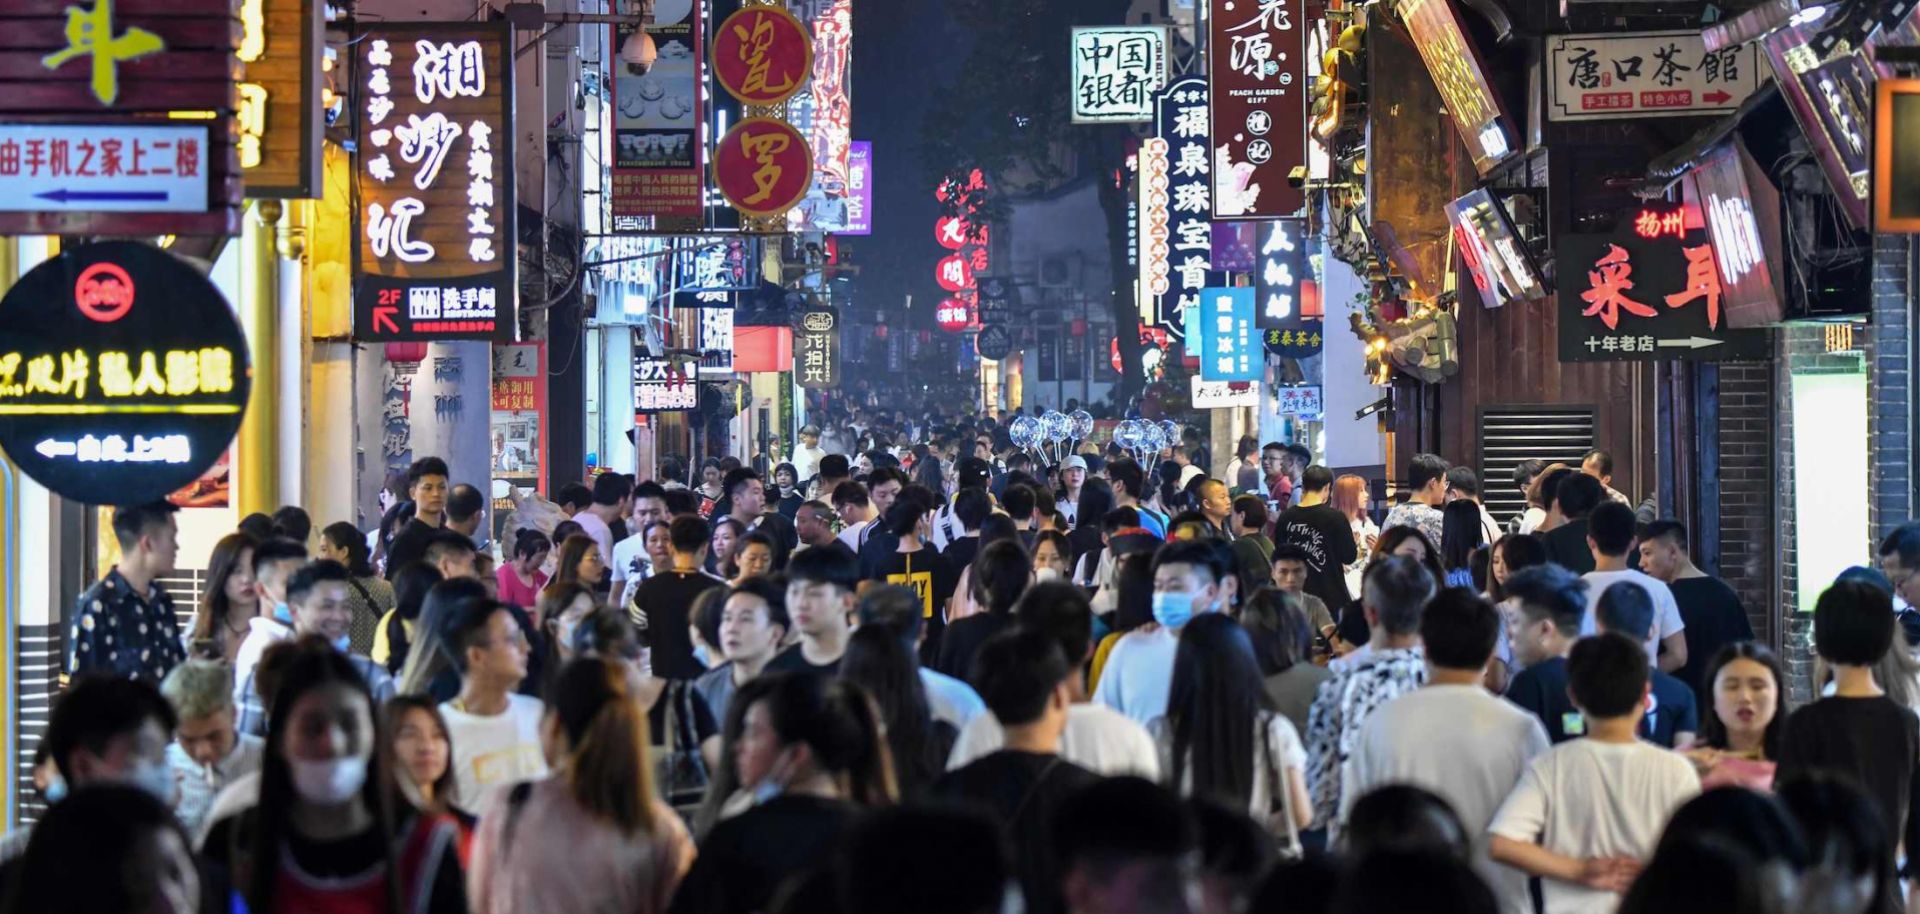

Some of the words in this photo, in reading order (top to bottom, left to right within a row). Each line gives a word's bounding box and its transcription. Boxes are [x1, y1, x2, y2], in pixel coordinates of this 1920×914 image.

[1080, 37, 1151, 75] 中国
[1080, 70, 1154, 109] 银都
[1643, 92, 1690, 105] 特色小吃
[0, 138, 199, 178] 由手机之家上二楼
[1635, 209, 1685, 239] 扬州
[378, 288, 402, 306] 2F
[1580, 243, 1721, 332] 采耳
[1584, 335, 1654, 352] 十年老店
